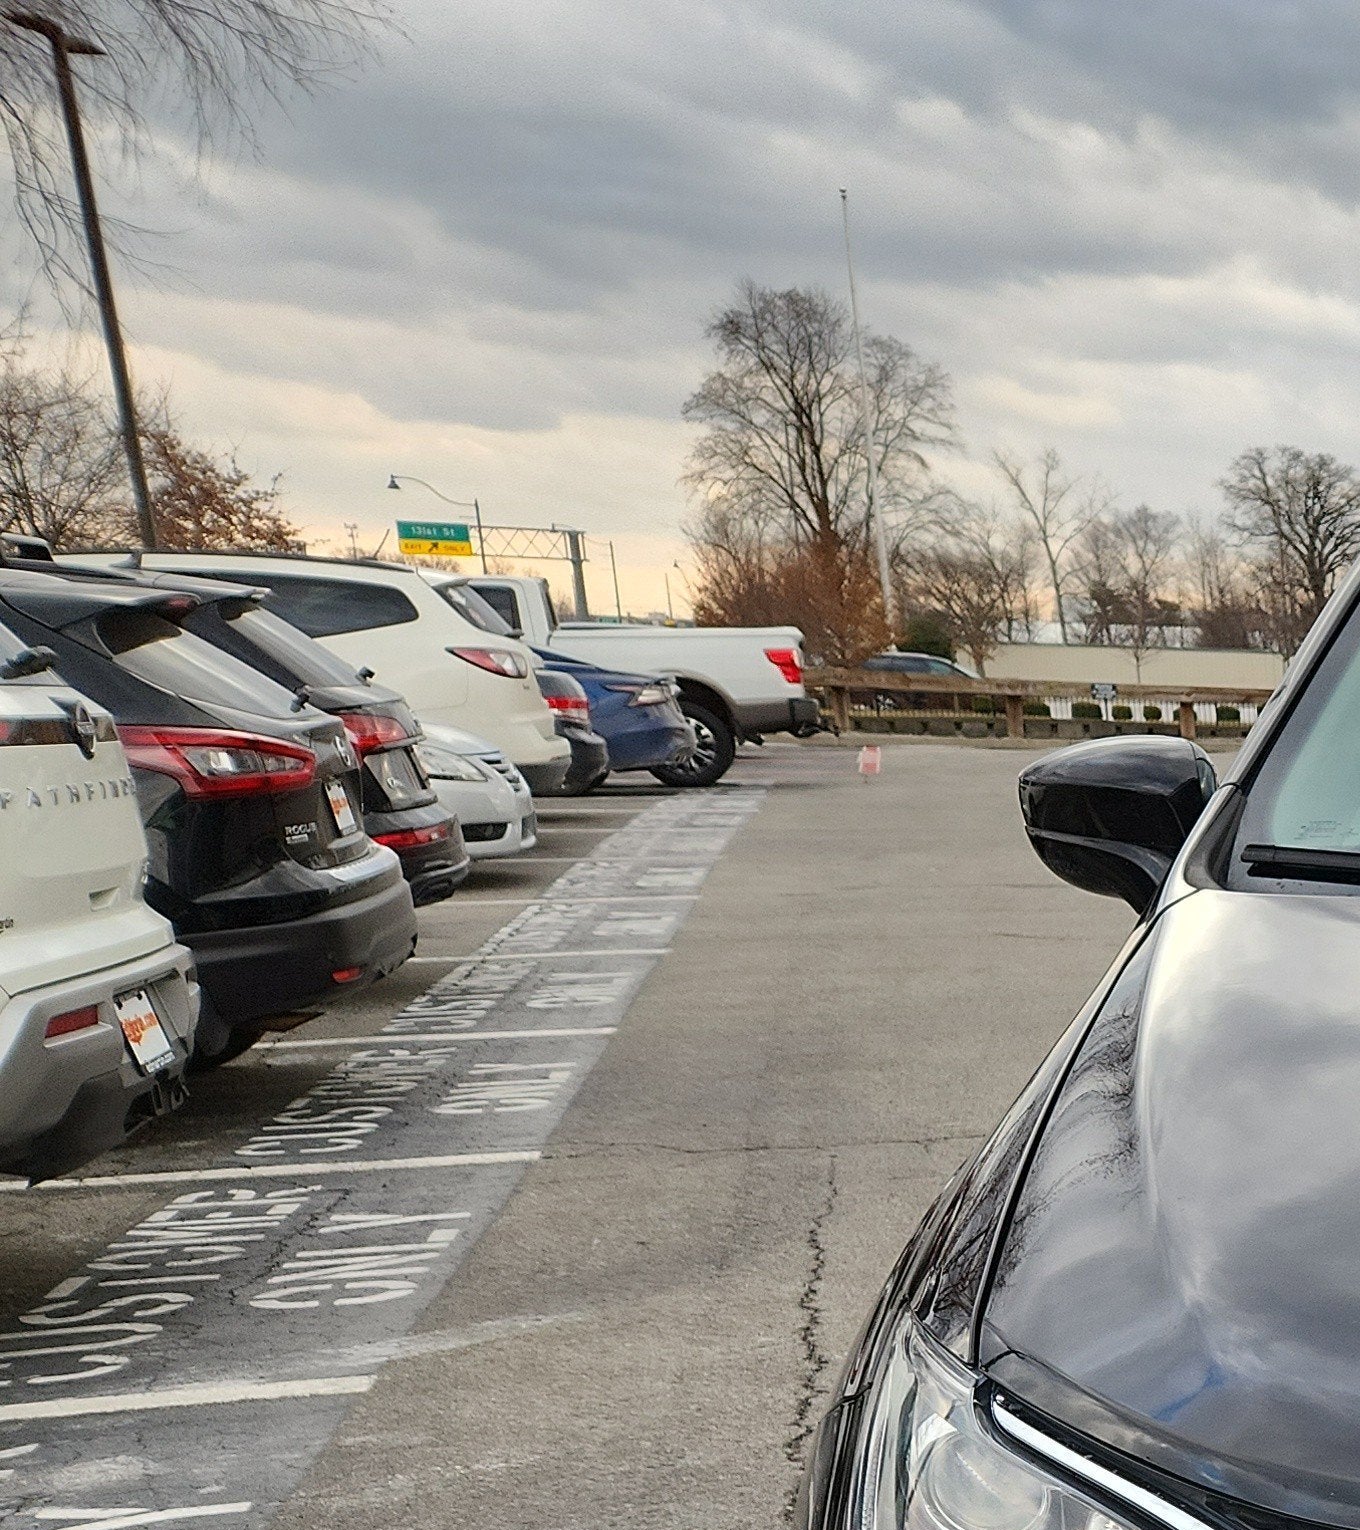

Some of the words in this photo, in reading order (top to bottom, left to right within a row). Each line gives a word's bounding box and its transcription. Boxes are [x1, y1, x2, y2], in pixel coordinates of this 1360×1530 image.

[442, 527, 455, 537] St
[284, 822, 317, 835] ROGUE
[428, 1061, 577, 1115] ONLY
[249, 1211, 471, 1309] ONLY
